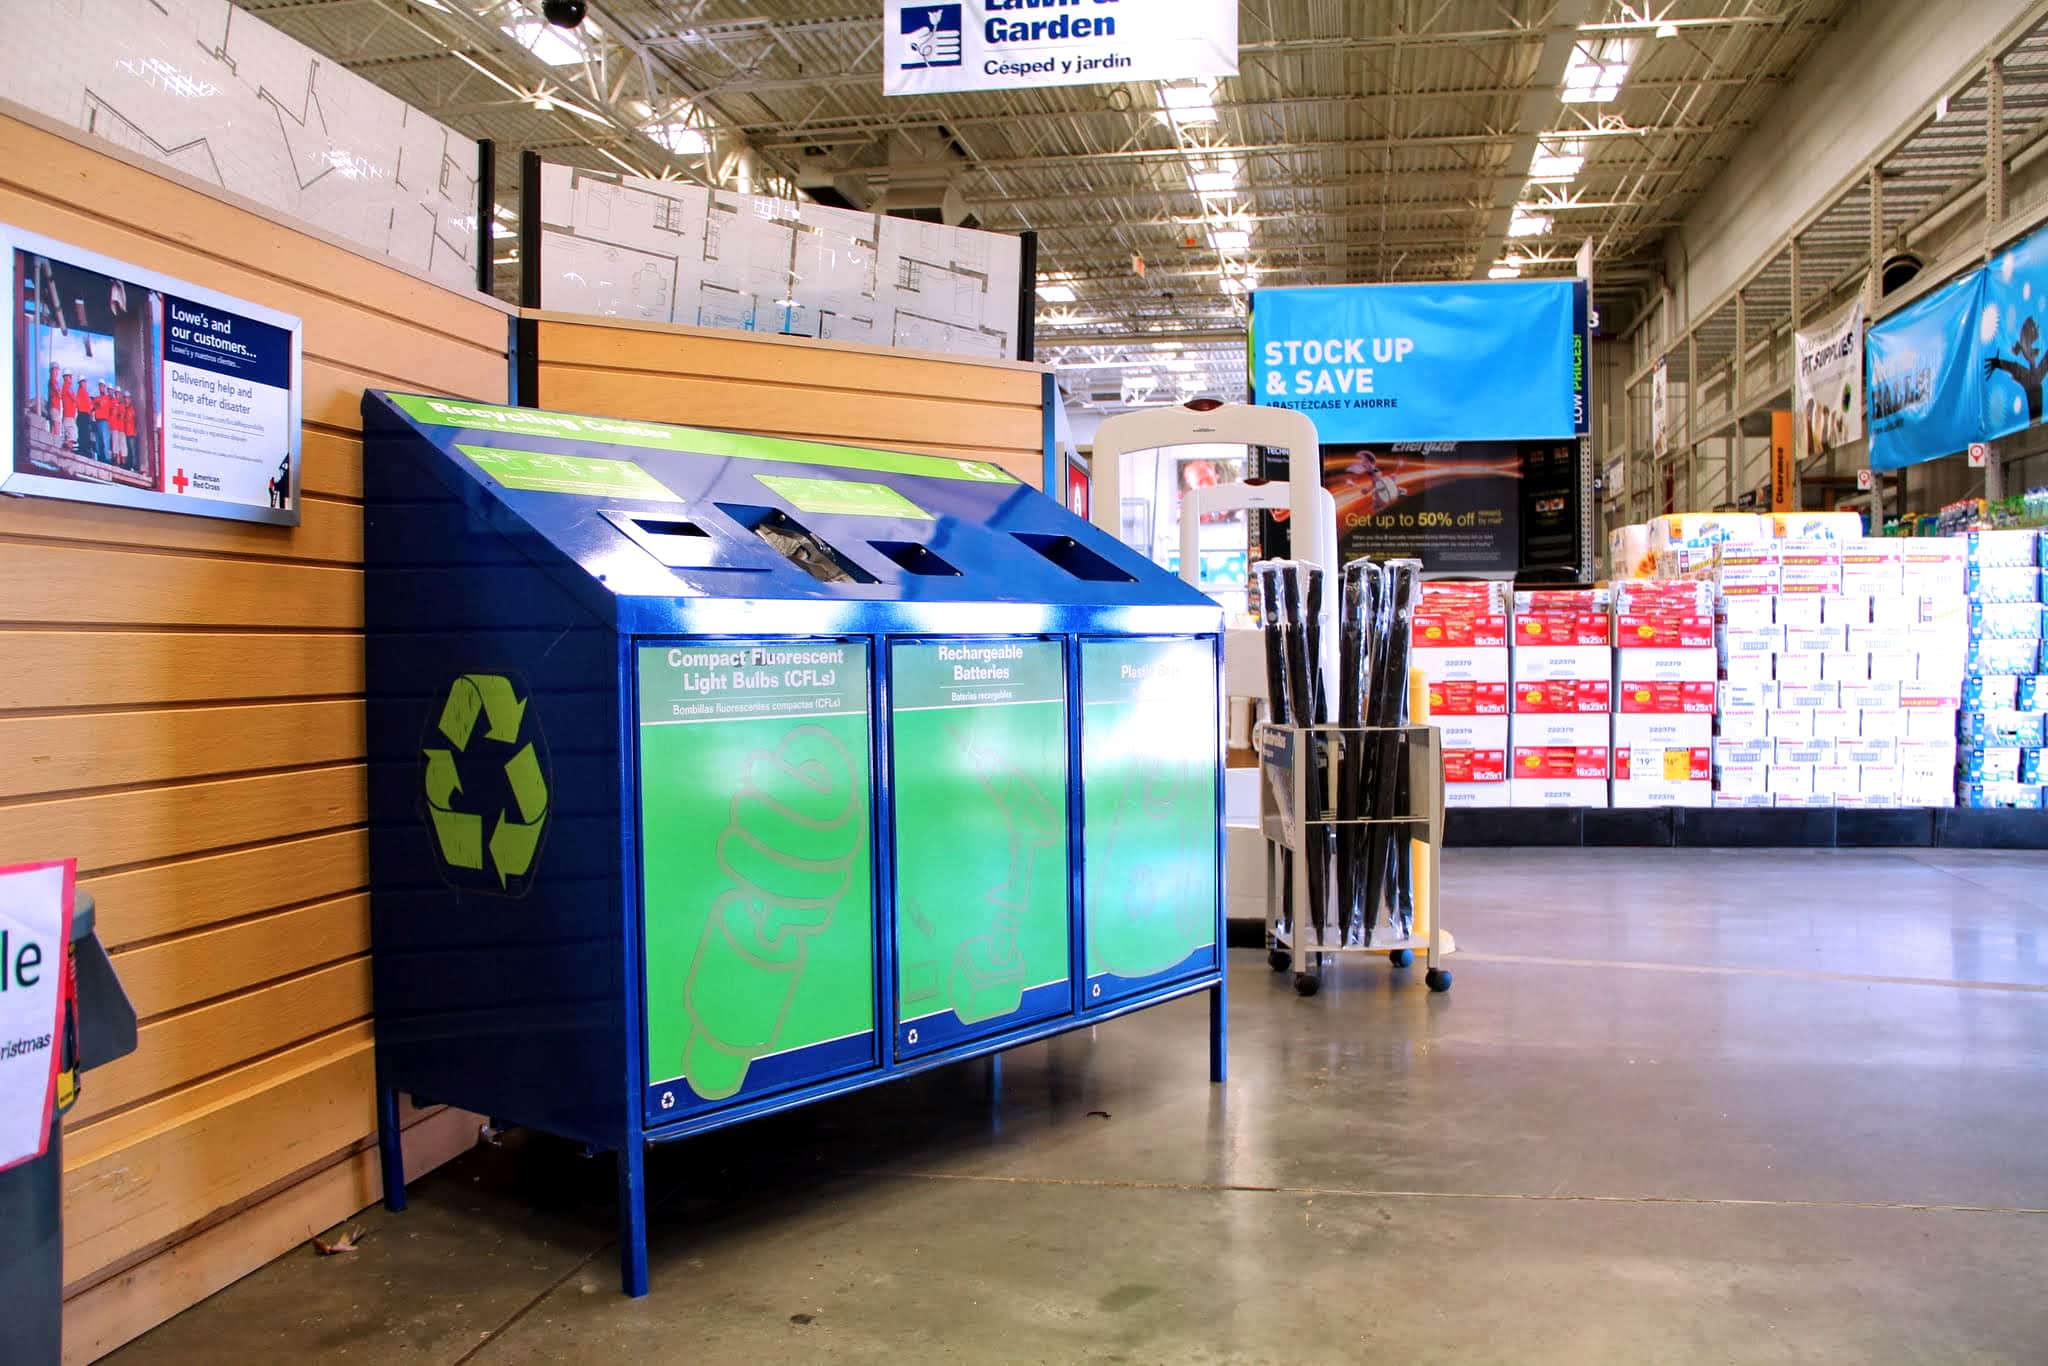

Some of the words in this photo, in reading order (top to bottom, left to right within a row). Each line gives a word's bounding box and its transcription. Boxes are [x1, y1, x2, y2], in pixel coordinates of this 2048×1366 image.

[984, 14, 1115, 44] Garden
[1062, 60, 1072, 75] y
[171, 304, 209, 328] Lowe's
[211, 320, 231, 335] and
[171, 326, 191, 340] our
[193, 331, 257, 358] customers...
[1264, 340, 1365, 366] STOCK
[1373, 337, 1414, 363] UP
[171, 369, 215, 394] Delivering
[217, 379, 236, 397] help
[237, 387, 253, 399] and
[1265, 370, 1288, 396] &
[1295, 368, 1374, 395] SAVE
[171, 386, 194, 405] hope
[196, 394, 217, 408] after
[219, 398, 251, 415] disaster
[1344, 399, 1351, 408] Y
[1353, 399, 1398, 409] AHORRE
[1574, 394, 1583, 424] LOW
[426, 401, 582, 431] Recycling
[1776, 447, 1784, 504] Clearance
[1345, 512, 1371, 527] Get
[1375, 514, 1395, 529] up
[1400, 513, 1415, 527] to
[1418, 512, 1453, 527] 50%
[1457, 512, 1476, 527] off
[667, 648, 745, 670] Compact
[751, 648, 844, 666] Fluorescent
[938, 644, 1024, 663] Rechargeable
[684, 671, 727, 695] Light
[732, 670, 779, 690] Bulbs
[784, 668, 836, 688] (CFLs)
[953, 663, 1010, 681] Batteries
[1121, 664, 1153, 679] Plas
[672, 703, 714, 716] Bombillas
